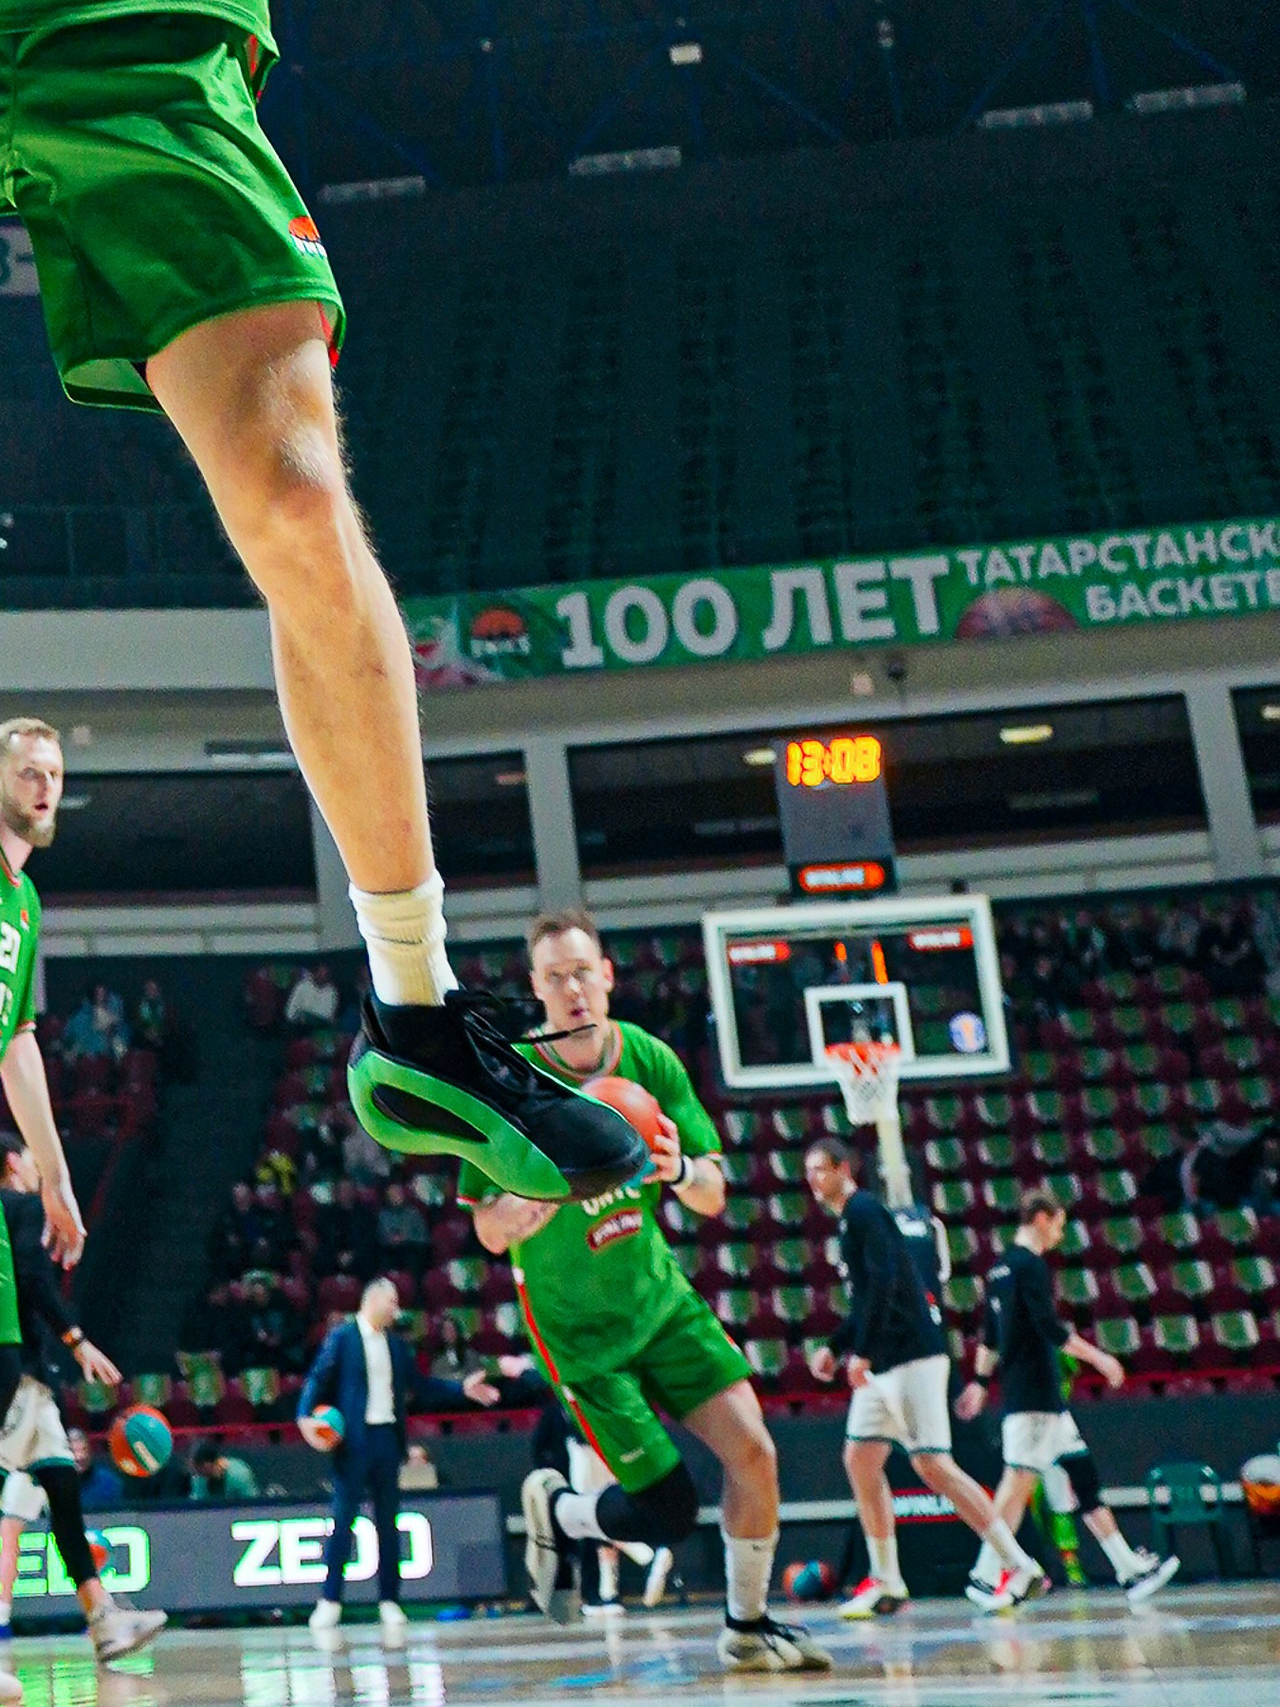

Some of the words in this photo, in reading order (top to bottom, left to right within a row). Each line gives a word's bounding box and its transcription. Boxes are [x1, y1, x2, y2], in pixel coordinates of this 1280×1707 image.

[556, 578, 738, 670] 100
[762, 555, 950, 652] ЛЕТ
[786, 736, 881, 787] 13:08
